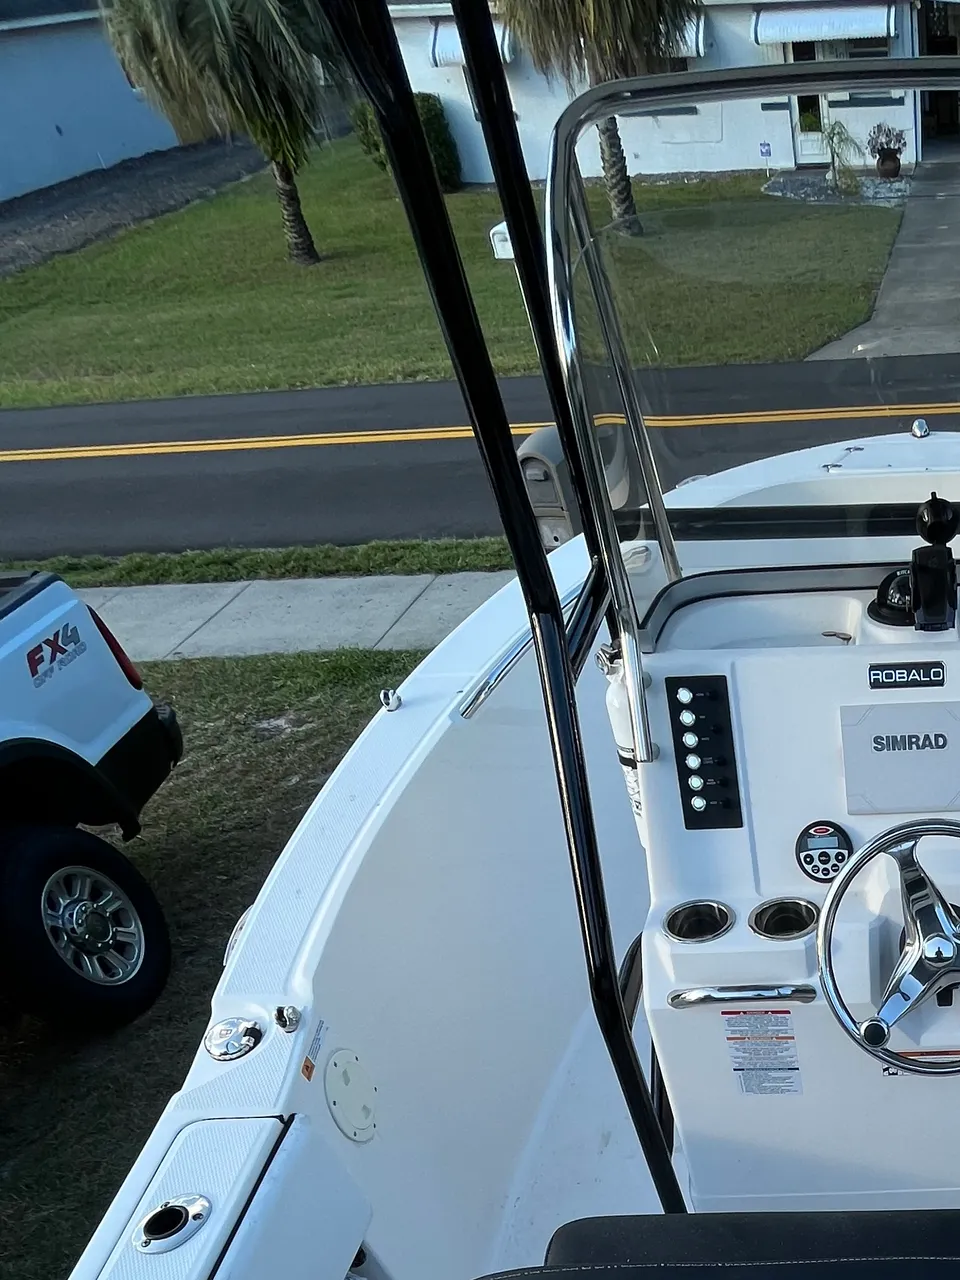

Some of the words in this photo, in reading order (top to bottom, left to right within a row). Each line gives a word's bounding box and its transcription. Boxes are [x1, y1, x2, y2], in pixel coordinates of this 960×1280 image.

[26, 622, 81, 678] FX4
[56, 641, 87, 671] ROAD
[870, 667, 943, 683] ROBALO
[872, 733, 948, 752] SIMRAD
